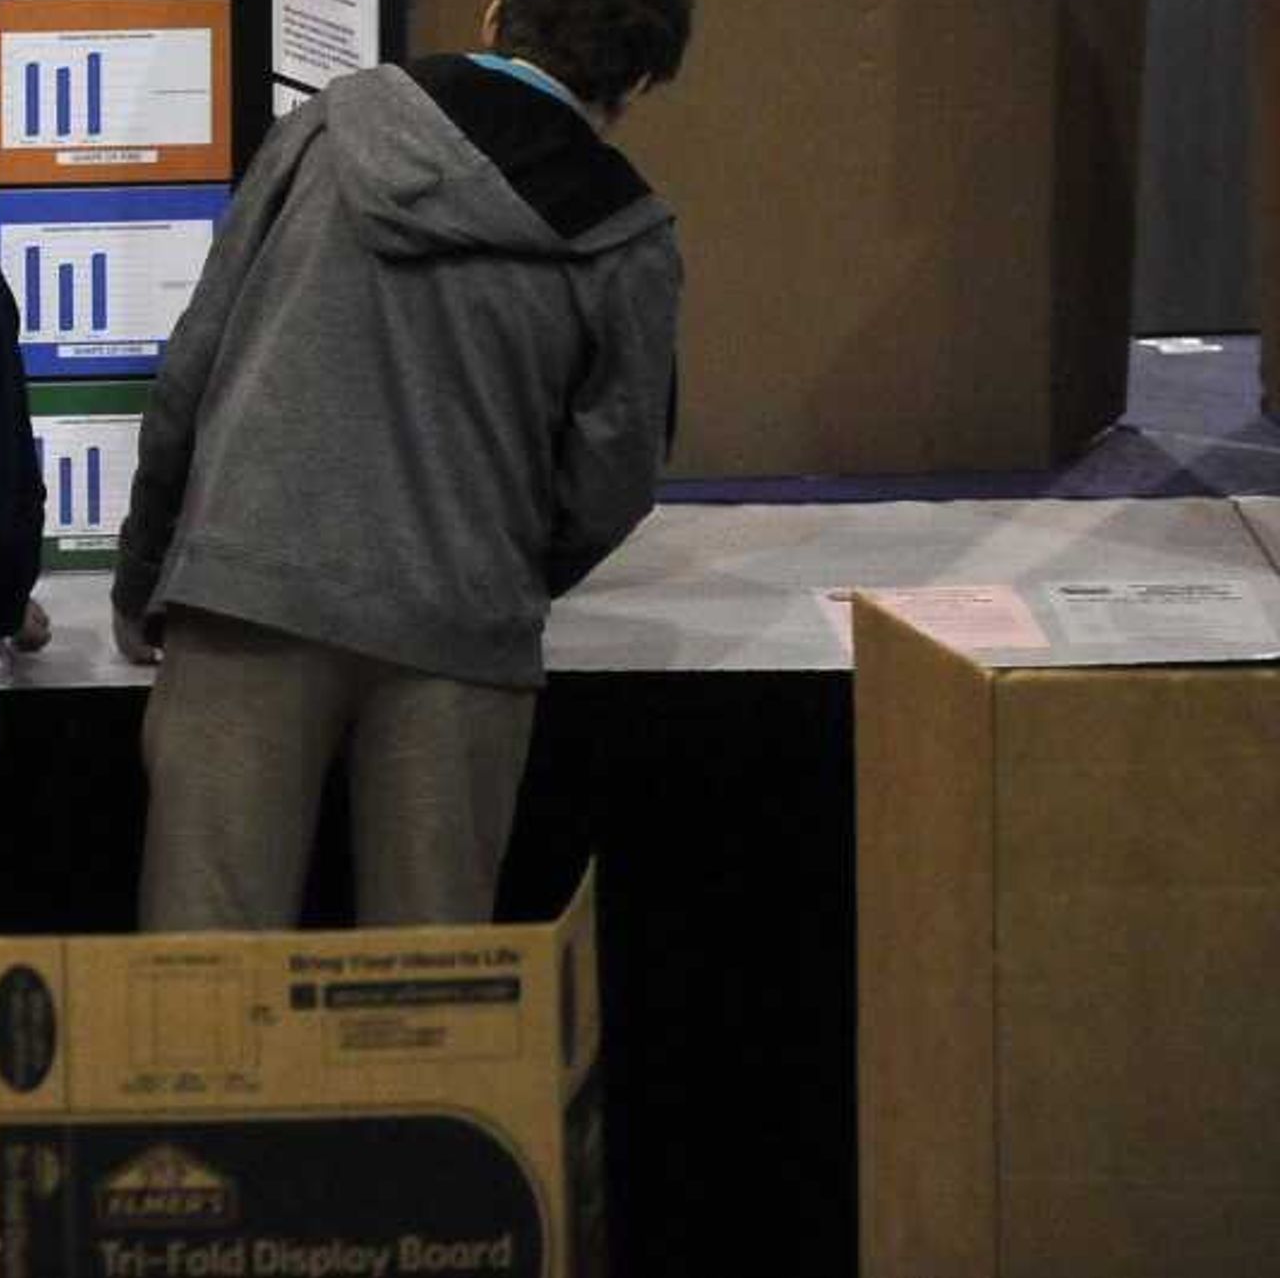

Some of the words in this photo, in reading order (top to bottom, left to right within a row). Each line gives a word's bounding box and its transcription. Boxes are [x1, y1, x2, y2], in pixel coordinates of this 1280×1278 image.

[100, 1238, 244, 1278] Tri-Fold
[252, 1236, 391, 1278] Display
[399, 1233, 513, 1273] Board
